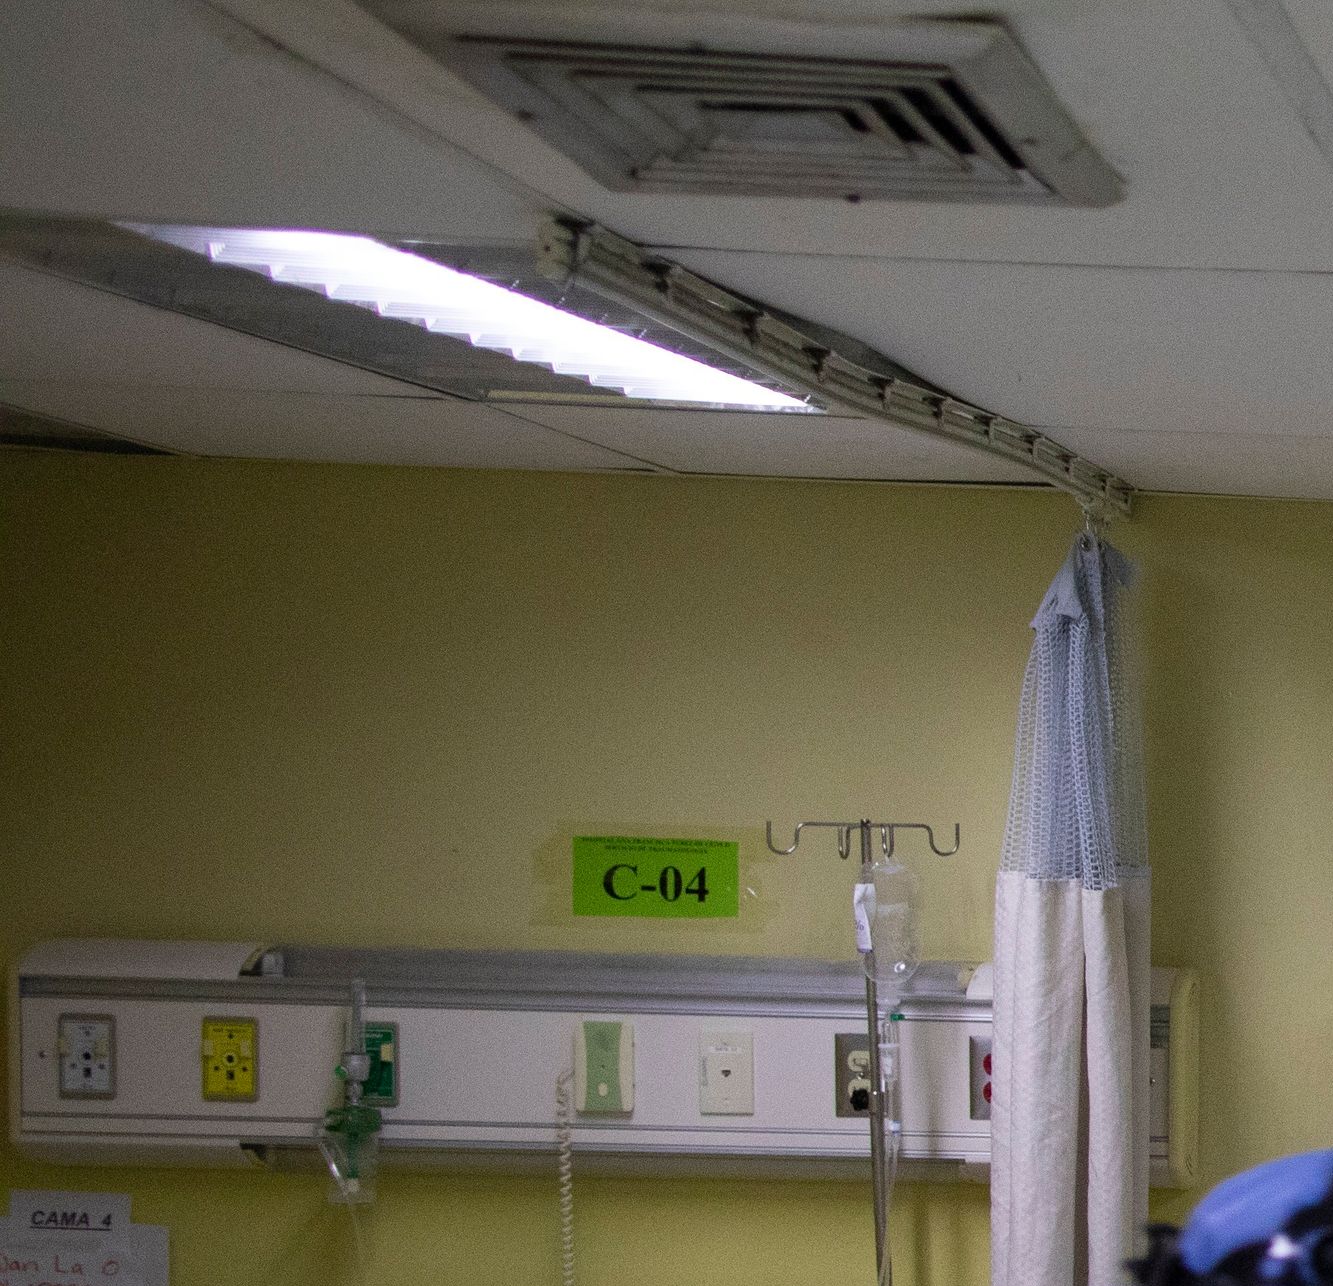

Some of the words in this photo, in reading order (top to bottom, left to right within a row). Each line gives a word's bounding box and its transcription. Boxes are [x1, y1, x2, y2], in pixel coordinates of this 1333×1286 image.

[602, 863, 710, 903] C-04
[30, 1211, 90, 1227] CAMA
[102, 1213, 113, 1228] 4
